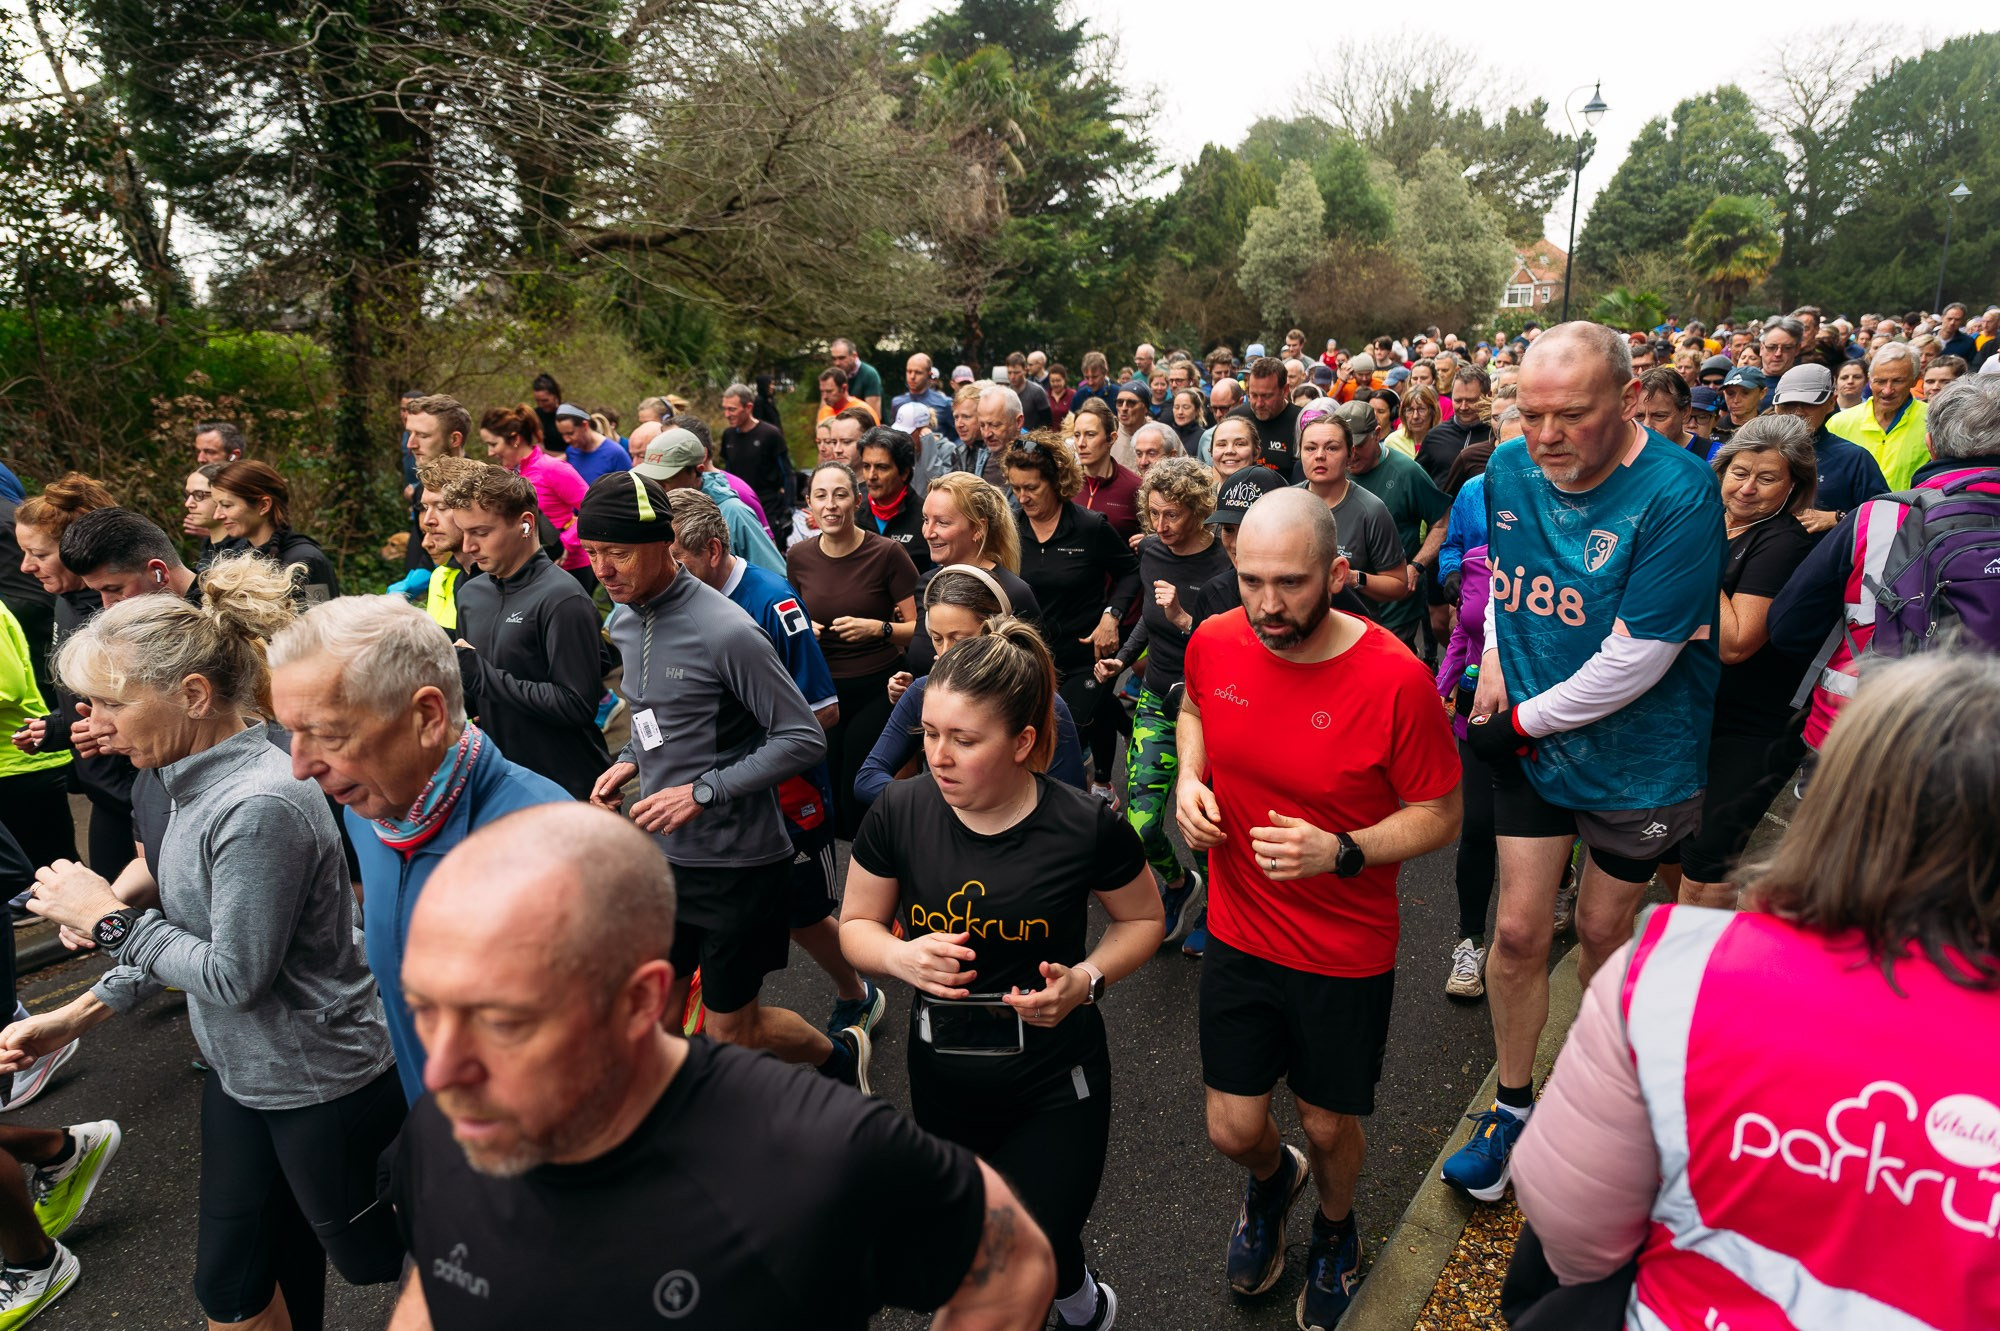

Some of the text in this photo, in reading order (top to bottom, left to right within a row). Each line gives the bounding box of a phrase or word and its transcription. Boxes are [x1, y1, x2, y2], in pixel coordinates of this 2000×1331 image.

[1485, 556, 1587, 627] bj88
[665, 666, 684, 680] HH
[1213, 684, 1249, 707] parkrun
[911, 880, 1049, 941] parkrun
[1729, 1080, 2000, 1238] parkru
[433, 1243, 490, 1299] parkrun
